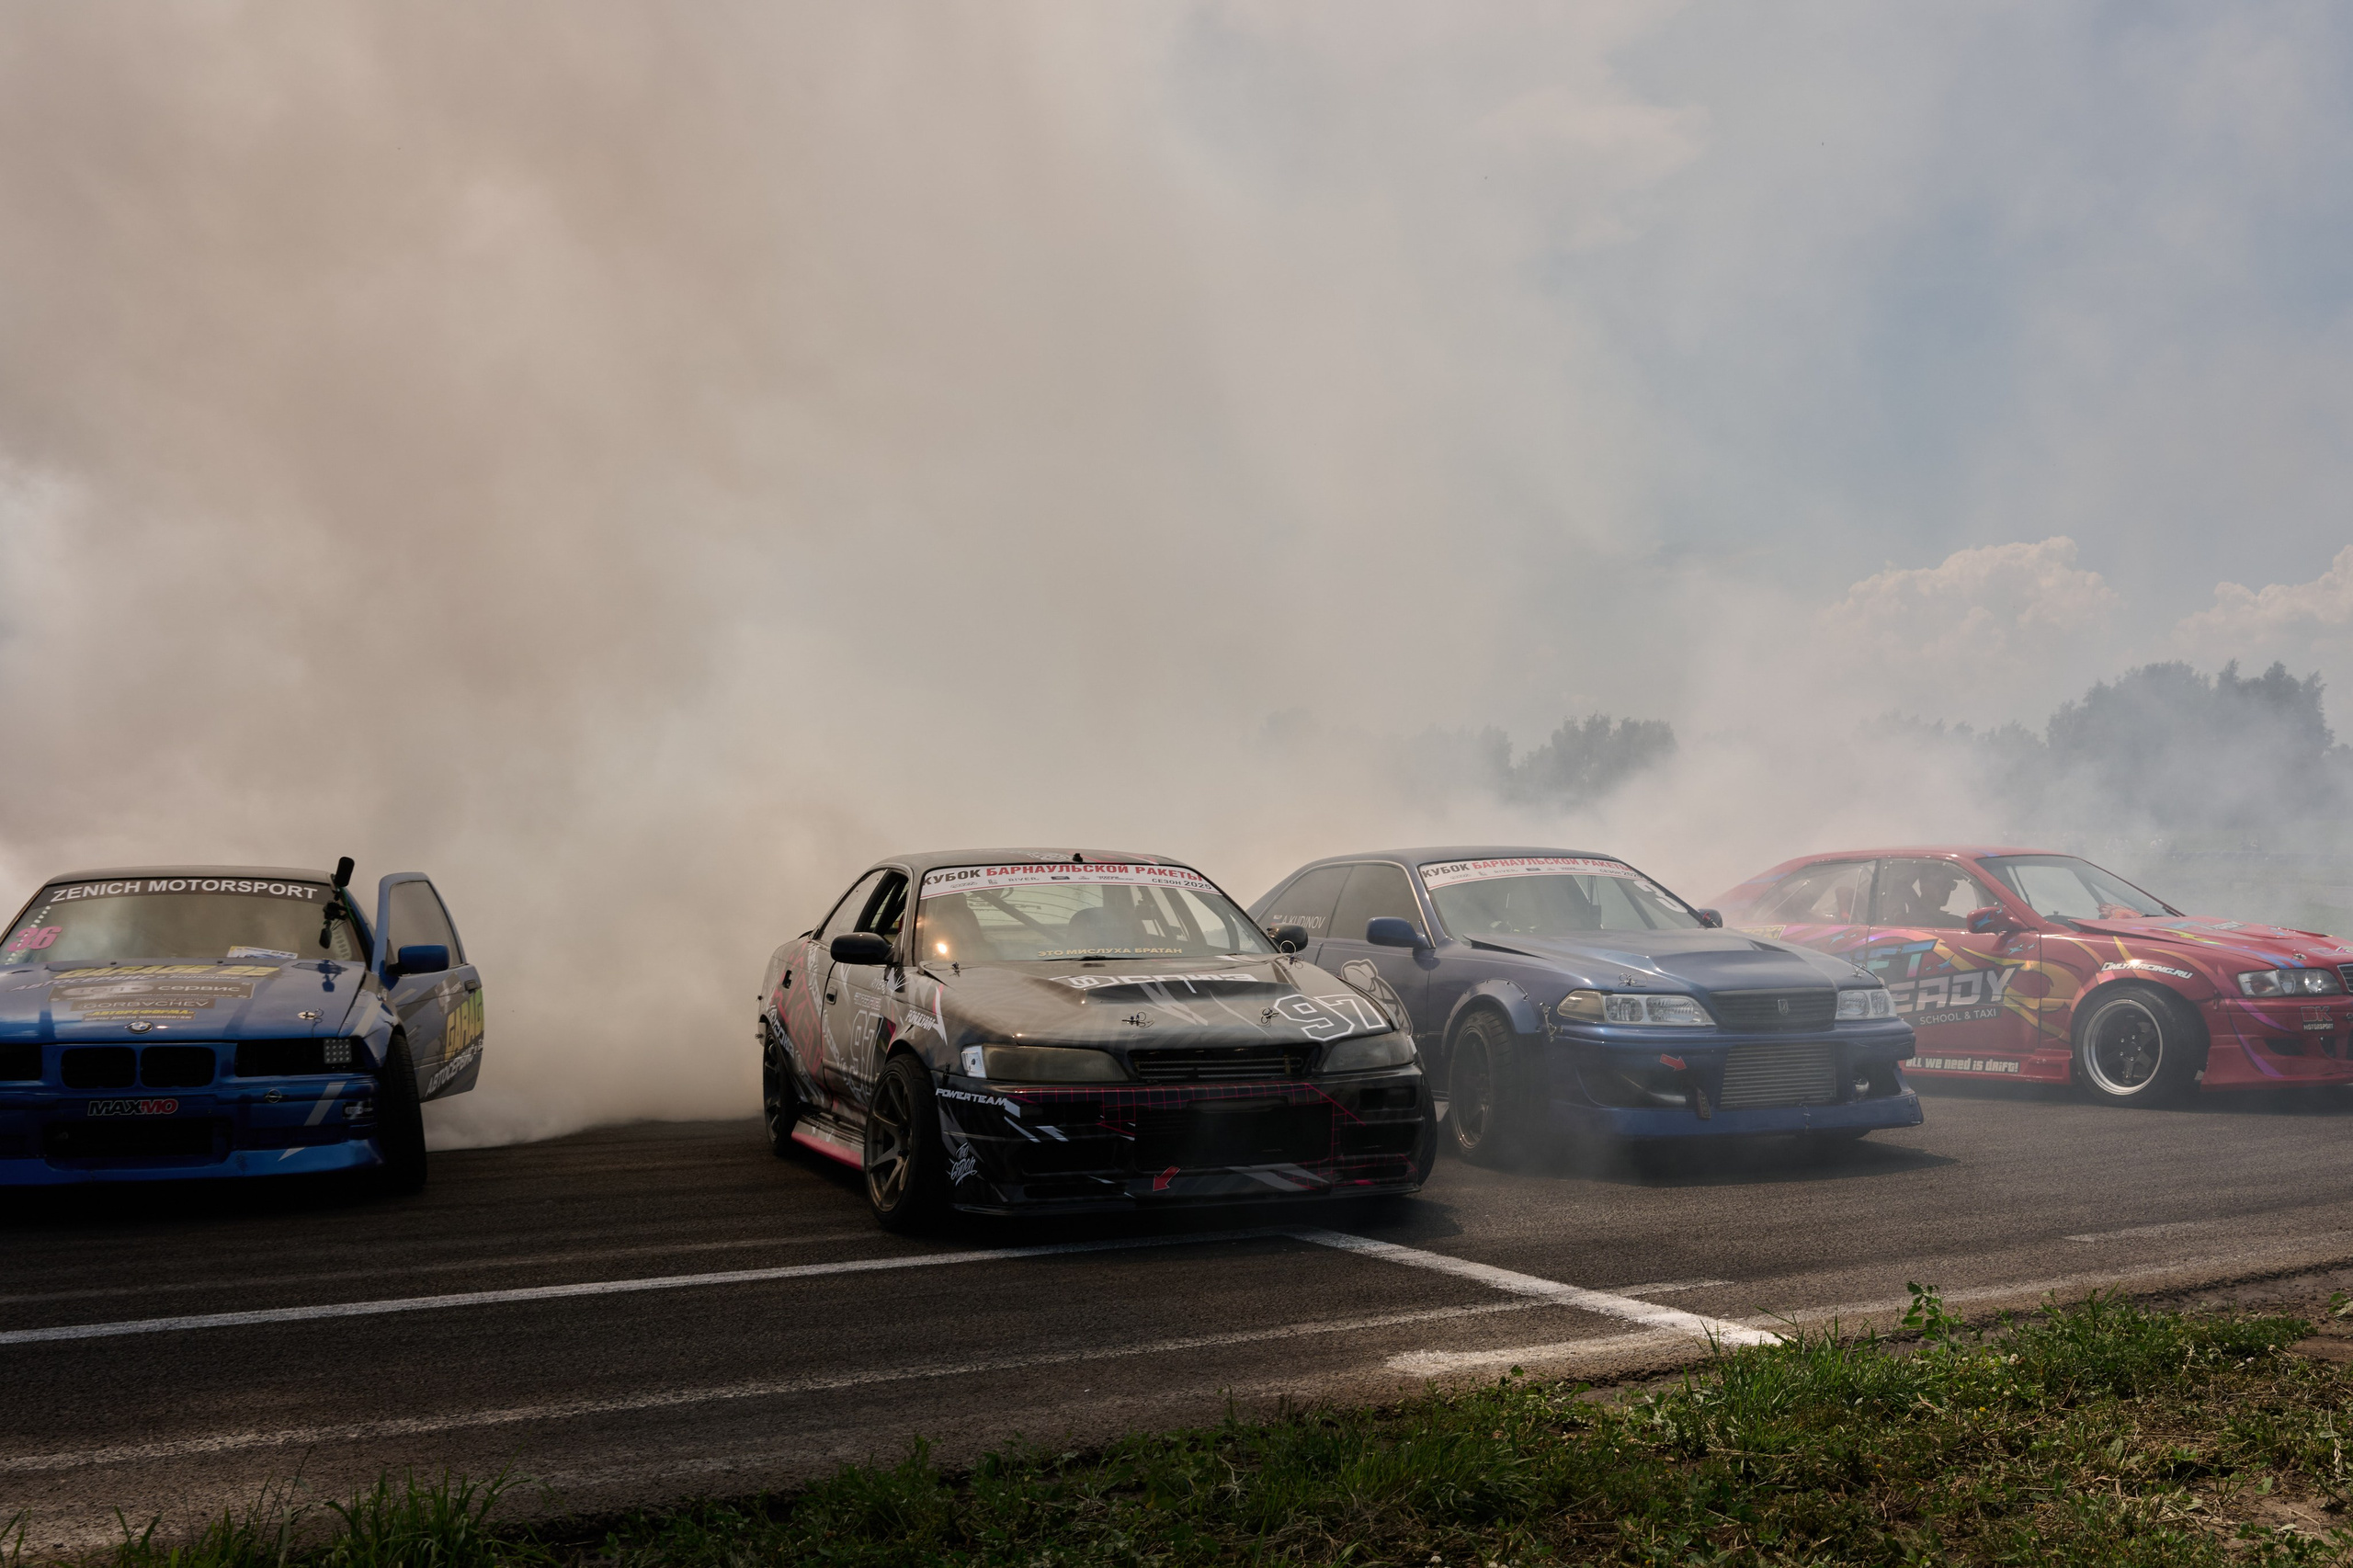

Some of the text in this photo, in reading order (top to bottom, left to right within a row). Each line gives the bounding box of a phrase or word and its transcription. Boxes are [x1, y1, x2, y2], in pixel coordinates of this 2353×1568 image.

[923, 869, 981, 886] КУБОК
[986, 864, 1129, 876] БАРНАУЛЬСКОЙ
[1135, 868, 1203, 881] РАКЕТЫ
[1422, 858, 1634, 878] КУБОК БАРНАУЛЬСКОЙ РАКЕТЫ
[50, 880, 318, 903] ZENICH MOTORSPORT
[1152, 878, 1182, 886] СЕЗОН
[6, 926, 63, 952] 36
[54, 965, 280, 980] GARAGE 22
[1889, 968, 2016, 1014] EADY
[1274, 994, 1387, 1042] 97
[1919, 1008, 1996, 1025] SCHOOL & TAXI
[2301, 1006, 2333, 1022] DK
[445, 988, 485, 1061] GARAG
[87, 1098, 179, 1116] MAXMO
[935, 1087, 1007, 1107] POWERTEAM
